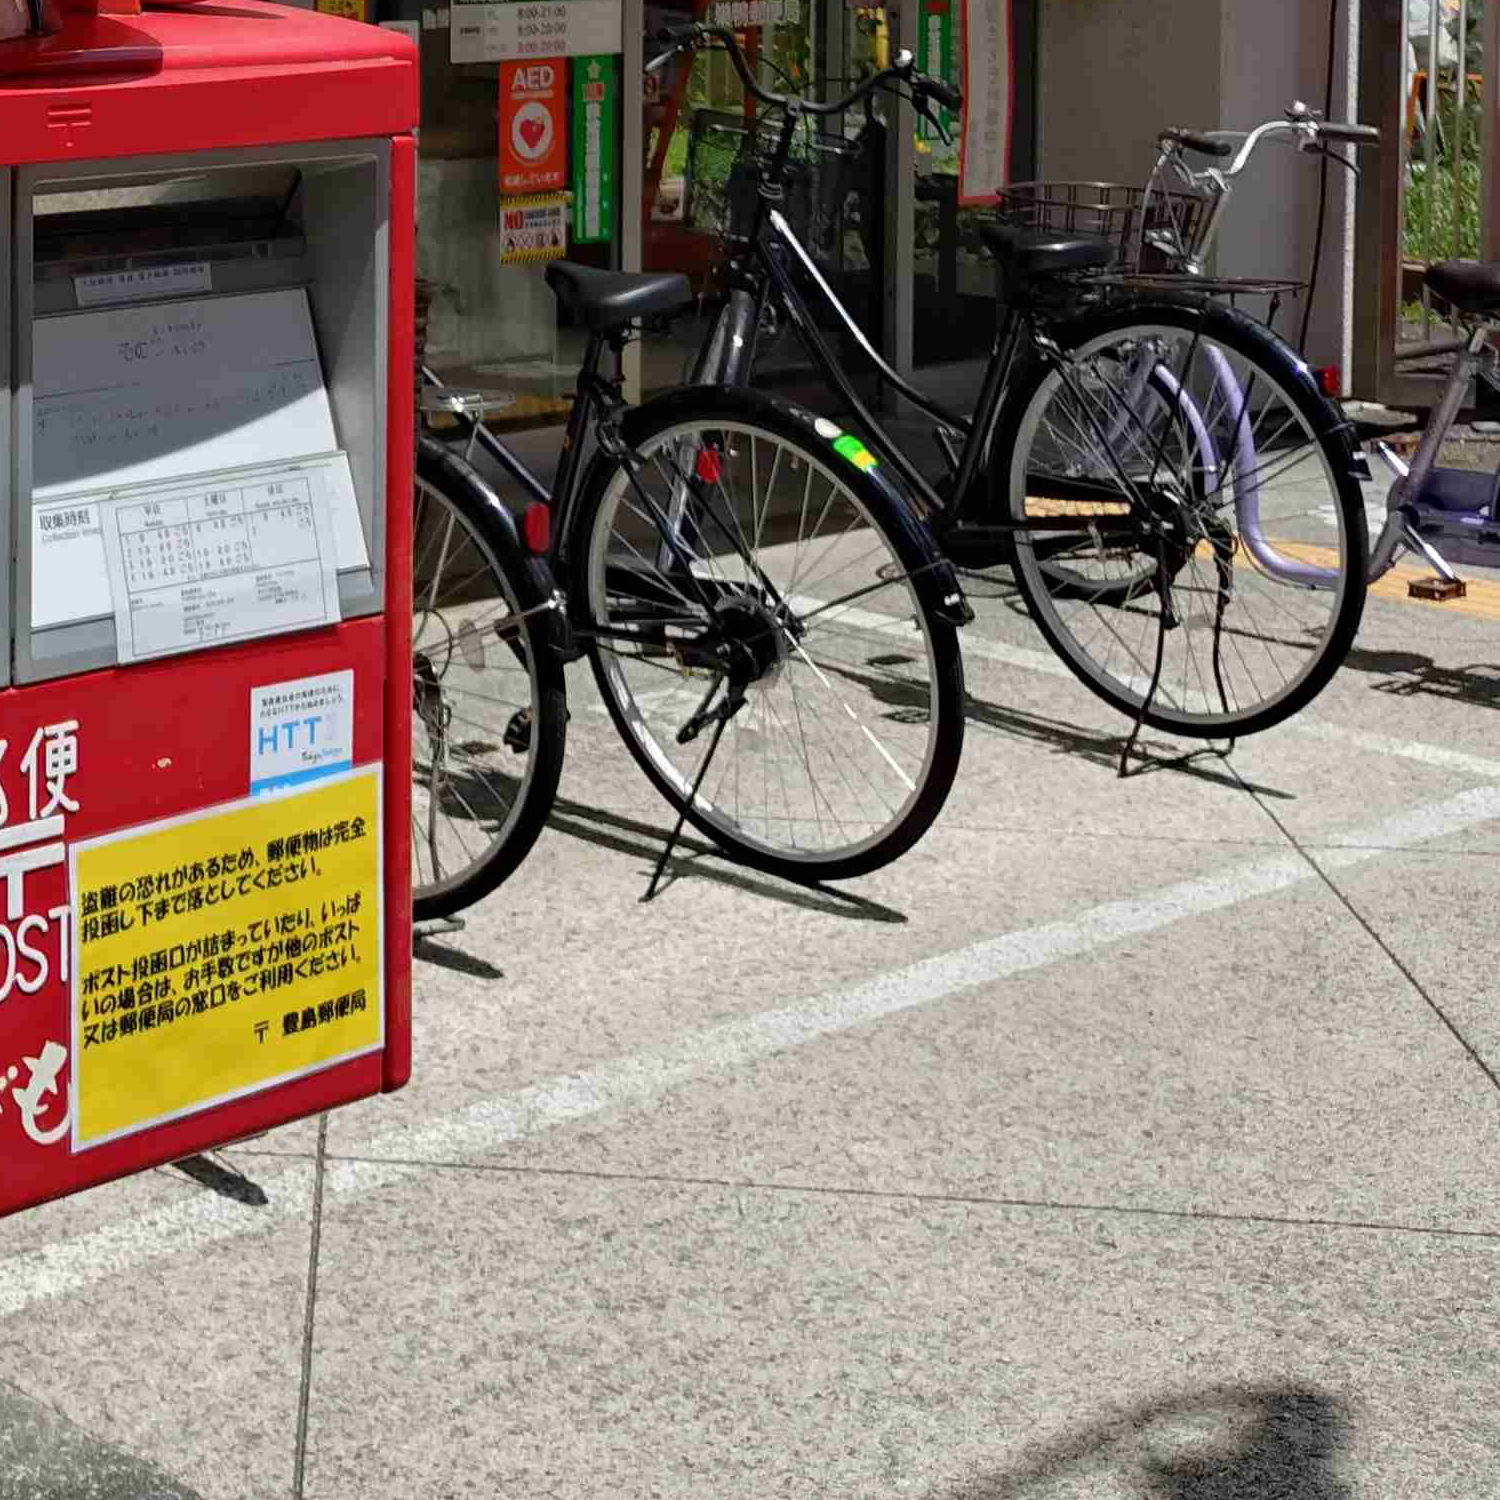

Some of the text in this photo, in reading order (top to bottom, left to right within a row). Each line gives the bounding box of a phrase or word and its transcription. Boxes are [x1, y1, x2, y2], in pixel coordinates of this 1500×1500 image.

[512, 67, 555, 92] AED
[258, 715, 322, 757] HTT
[81, 816, 367, 916] 盗難の恐れがあるため、郵便物は完全
[82, 920, 361, 1022] いの場合は、お手数ですが他のポスト
[83, 945, 362, 1050] 又は郵便局の窓口をご利用ください。
[282, 988, 367, 1037] 豊島郵便局
